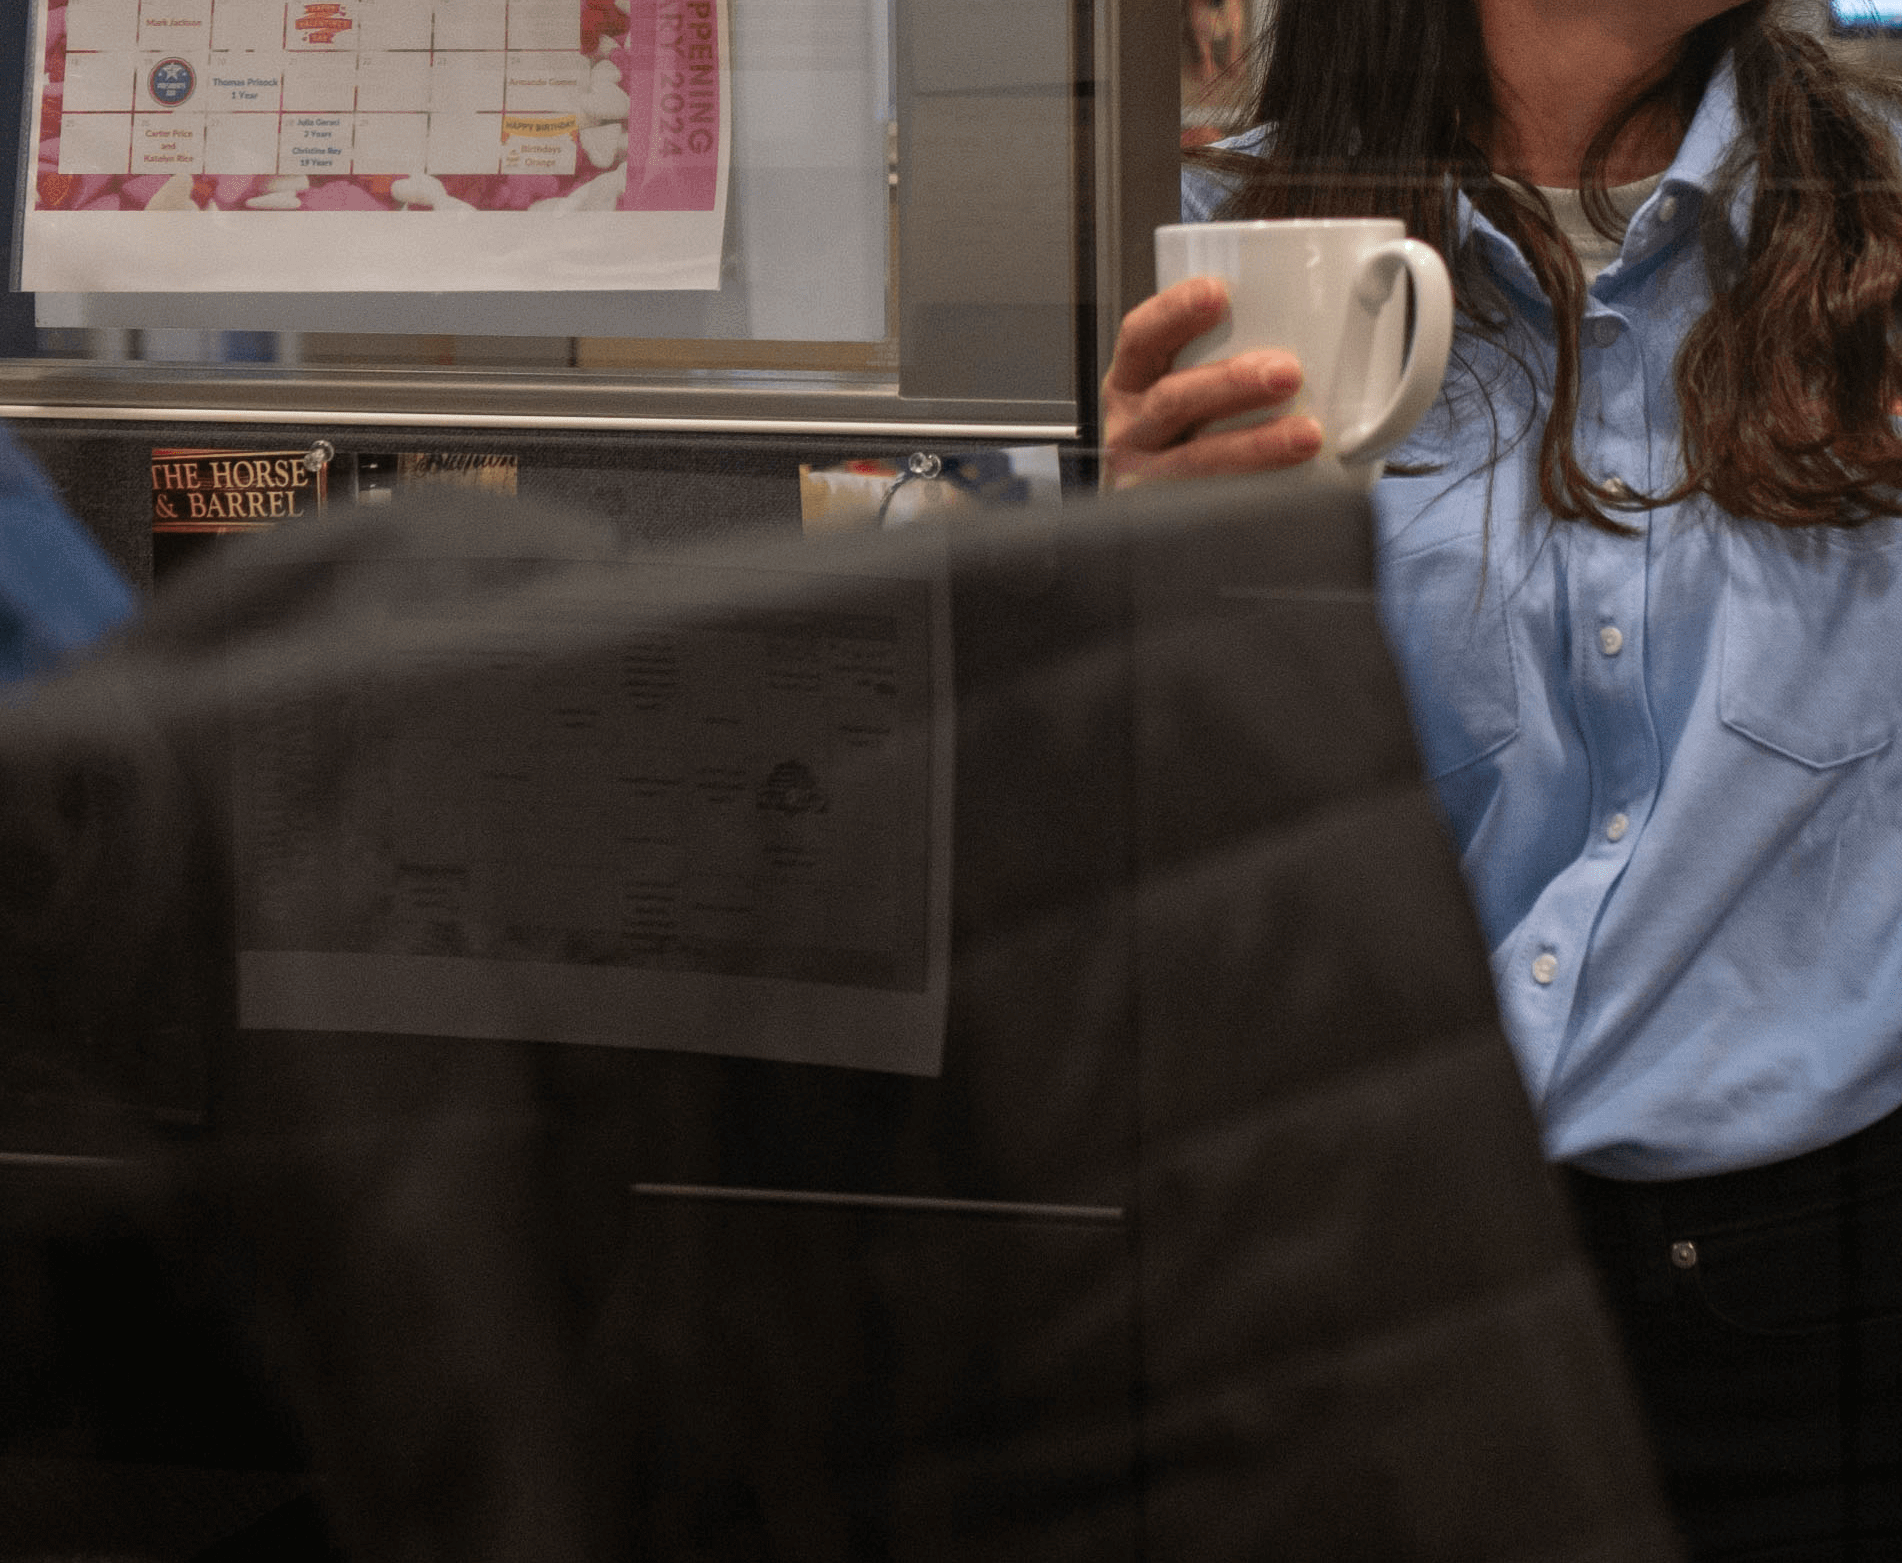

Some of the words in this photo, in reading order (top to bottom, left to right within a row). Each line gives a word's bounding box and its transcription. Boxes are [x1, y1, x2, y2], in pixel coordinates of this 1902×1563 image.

[213, 77, 245, 87] Thomas
[659, 73, 685, 157] 2024
[152, 462, 201, 490] THE
[209, 458, 309, 489] HORSE
[155, 493, 178, 518] &
[187, 490, 305, 518] BARREL
